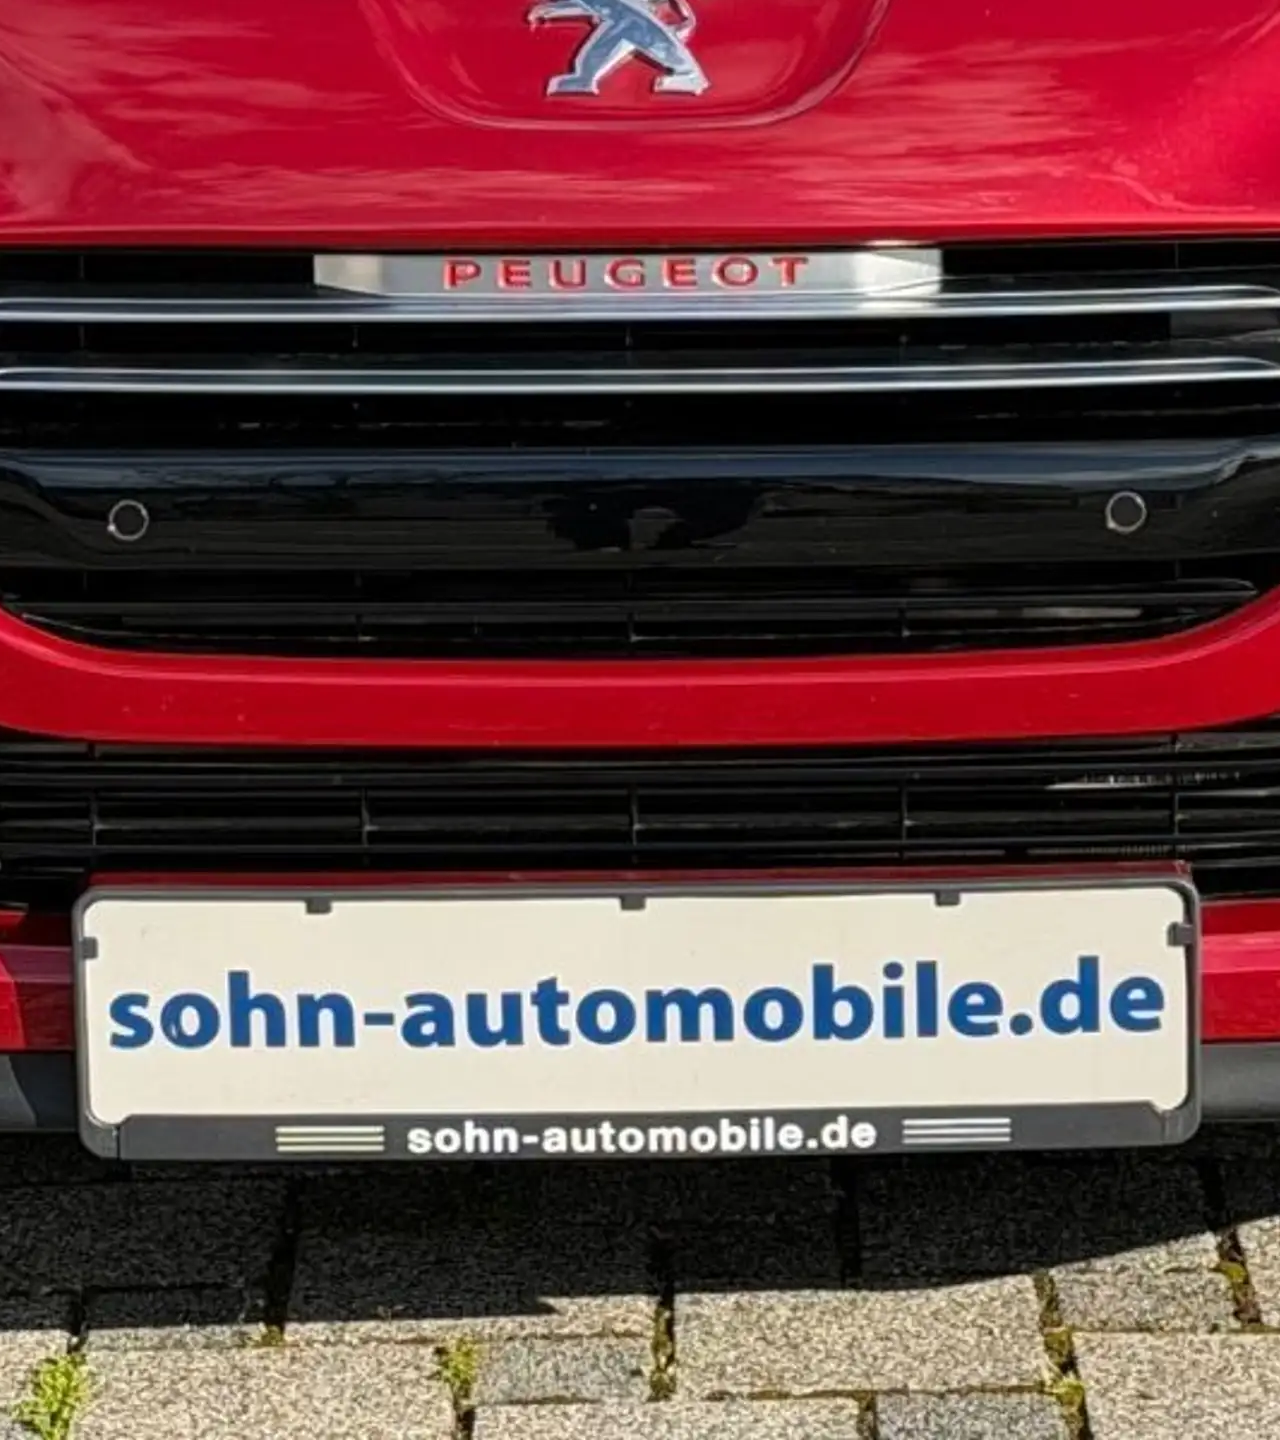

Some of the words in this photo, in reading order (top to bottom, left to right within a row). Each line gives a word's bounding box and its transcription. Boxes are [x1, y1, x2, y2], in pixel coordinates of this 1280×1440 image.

[444, 255, 810, 290] PEUGEOT
[108, 956, 1166, 1050] sohn-automobile.de
[407, 1116, 877, 1154] sohn-automobile.de
